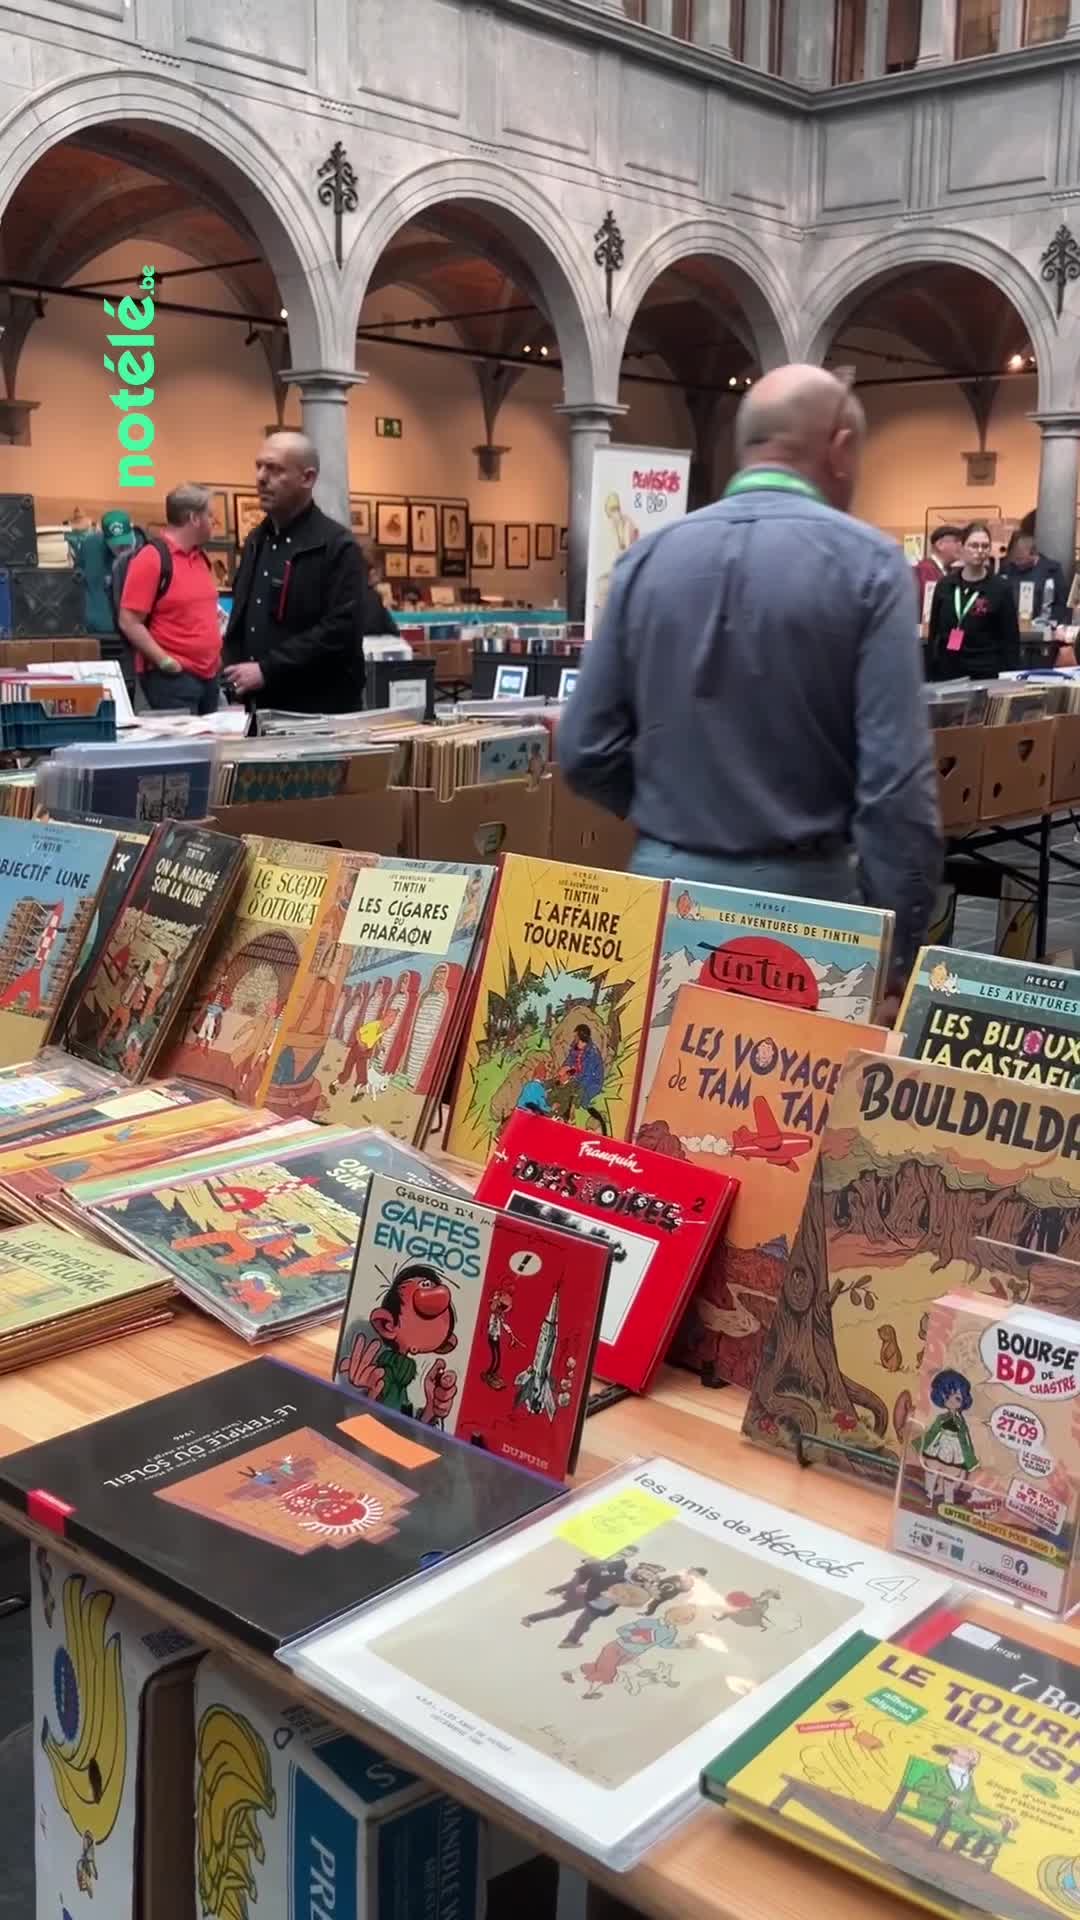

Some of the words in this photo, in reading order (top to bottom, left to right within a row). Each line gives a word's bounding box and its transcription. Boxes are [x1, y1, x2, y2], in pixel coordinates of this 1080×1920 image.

[0, 858, 52, 883] BJECTIF
[55, 868, 91, 890] LUNE
[155, 858, 170, 874] ON
[169, 861, 180, 878] A
[178, 864, 221, 892] MARCHÉ
[393, 880, 427, 894] TINTIN
[151, 875, 170, 895] SUR
[169, 880, 183, 900] LA
[181, 885, 208, 908] LUNE
[563, 887, 600, 905] TINTIN
[357, 896, 382, 914] LES
[388, 899, 449, 921] CIGARES
[533, 899, 621, 936] L'AFFAIRE
[359, 922, 432, 947] PHARAON
[523, 922, 624, 963] TOURNESOL
[719, 912, 736, 923] LES
[740, 914, 798, 935] AVENTURES
[803, 925, 817, 937] DE
[823, 929, 860, 945] TINTIN
[1026, 974, 1065, 989] HERGÉ
[979, 985, 1002, 998] LES
[1005, 990, 1078, 1013] AVENTURES
[920, 1038, 952, 1068] LA
[929, 1009, 973, 1041] LES
[982, 1020, 1080, 1065] BIJOUX
[680, 1023, 724, 1062] LES
[734, 1032, 843, 1096] VOYAGE
[668, 1057, 688, 1092] de
[697, 1067, 752, 1111] TAM
[859, 1062, 1080, 1161] BOULDALDA
[338, 1158, 374, 1177] ON
[578, 1140, 643, 1174] Franquin
[326, 1170, 368, 1191] SUR
[395, 1185, 449, 1212] Gaston
[381, 1200, 481, 1250] GAFFES
[996, 1327, 1080, 1370] BOURSE
[996, 1352, 1036, 1385] BD
[1029, 1375, 1077, 1395] CHASTRE
[273, 1404, 298, 1418] LE
[205, 1415, 275, 1447] TEMPLE
[996, 1416, 1039, 1441] 27.09
[174, 1444, 206, 1462] DU
[502, 1442, 549, 1470] DUPUIS
[103, 1459, 171, 1488] SOLEIL
[633, 1472, 667, 1496] les
[668, 1490, 722, 1522] amis
[722, 1516, 752, 1536] de
[864, 1574, 921, 1605] 4
[876, 1654, 936, 1688] LE
[1011, 1672, 1039, 1693] 7
[1037, 1684, 1080, 1717] Bo
